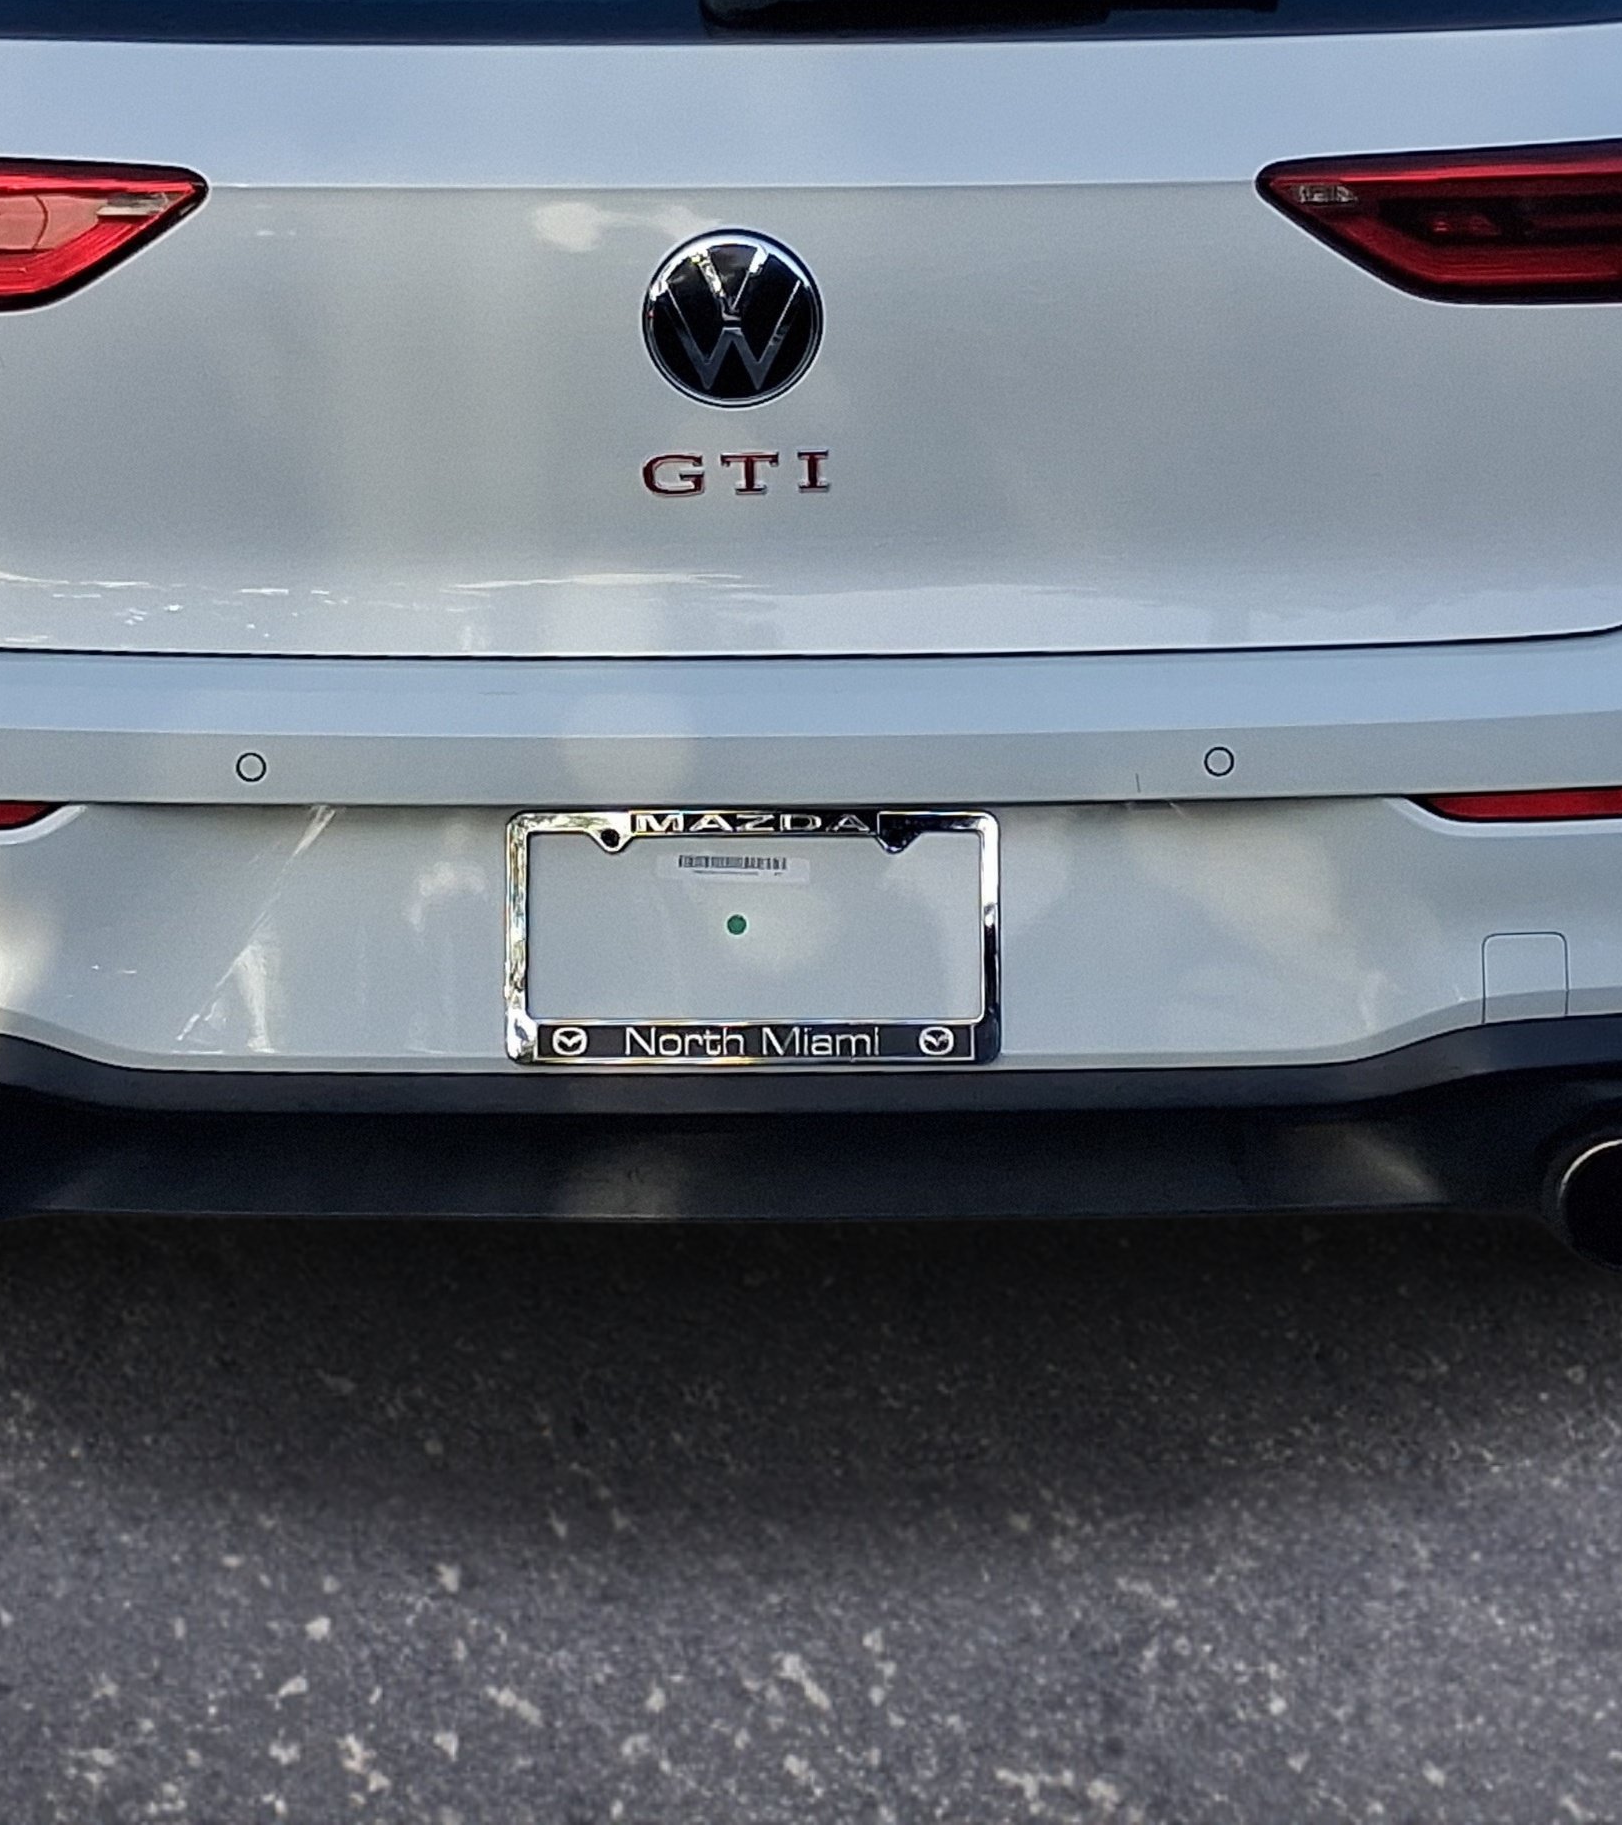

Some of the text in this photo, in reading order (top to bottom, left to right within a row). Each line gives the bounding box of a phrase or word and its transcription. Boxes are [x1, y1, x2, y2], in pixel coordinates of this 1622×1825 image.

[647, 236, 817, 396] VW
[641, 447, 830, 497] GTI
[635, 812, 871, 833] MAZDA
[624, 1027, 880, 1057] North Miami
